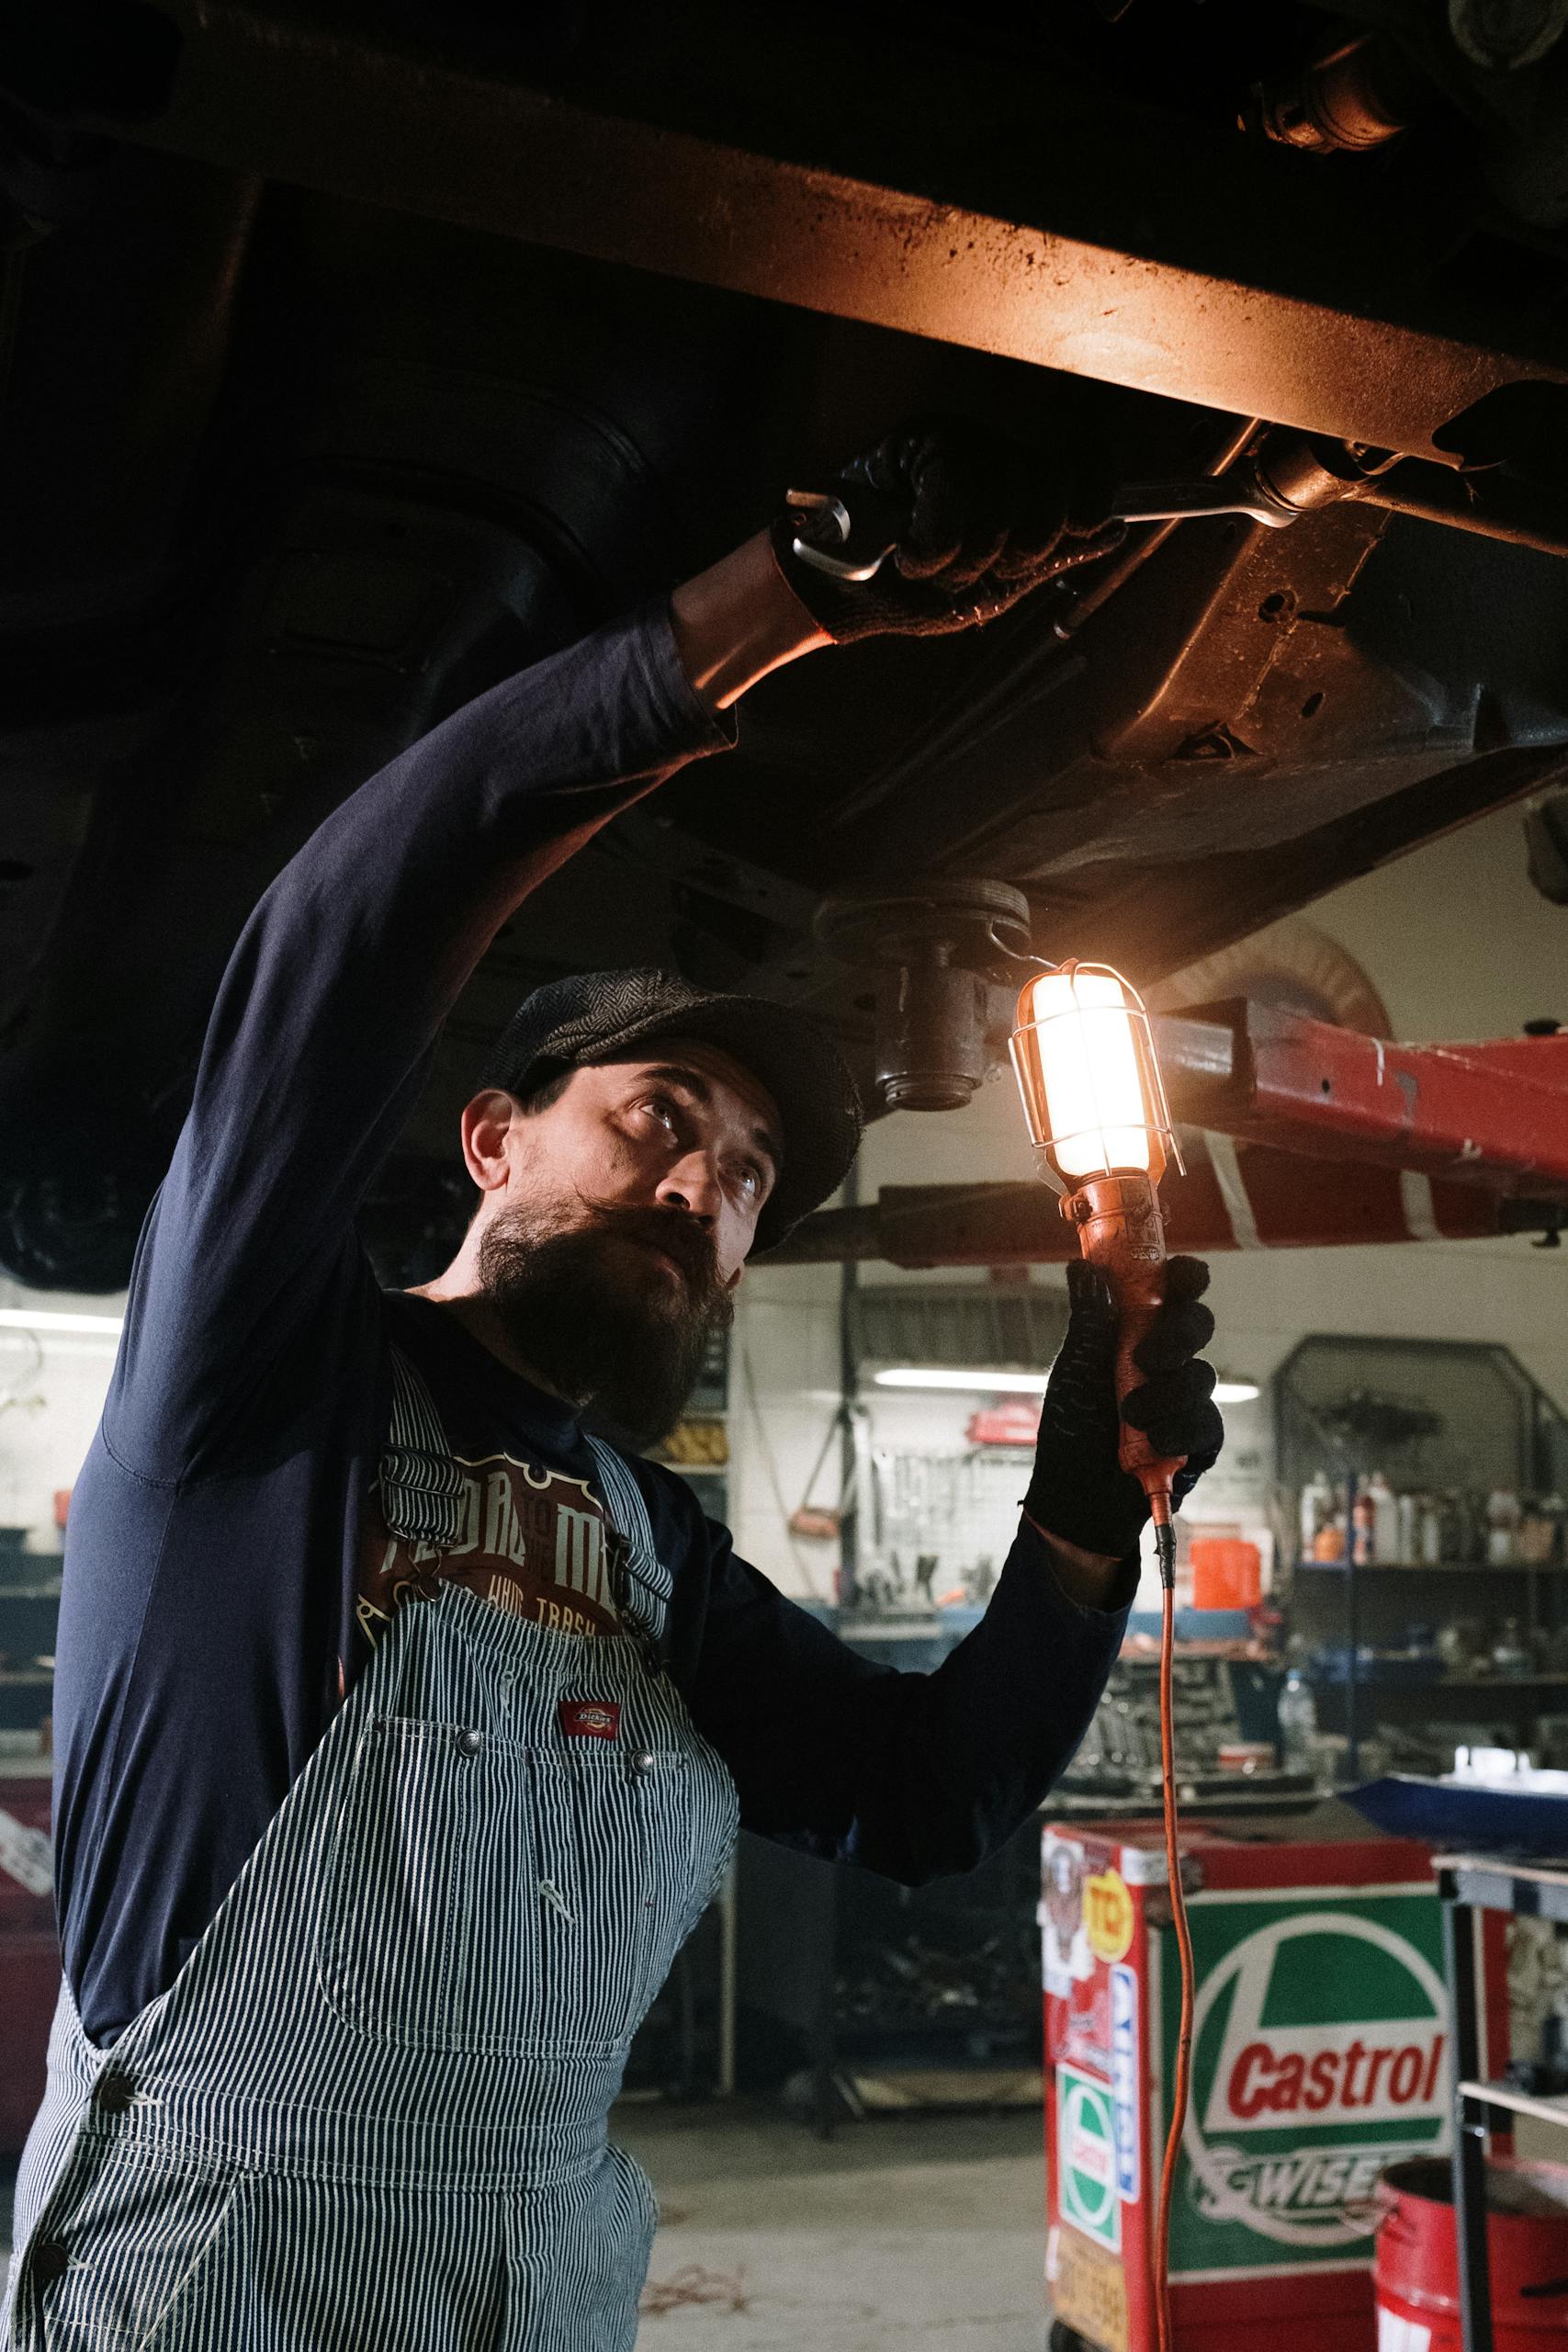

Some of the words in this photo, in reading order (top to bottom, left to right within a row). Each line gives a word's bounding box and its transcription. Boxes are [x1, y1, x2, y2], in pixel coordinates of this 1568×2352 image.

[536, 1597, 596, 1635] TRASH
[578, 1713, 612, 1724] Dickies
[1227, 2033, 1447, 2118] Castrol
